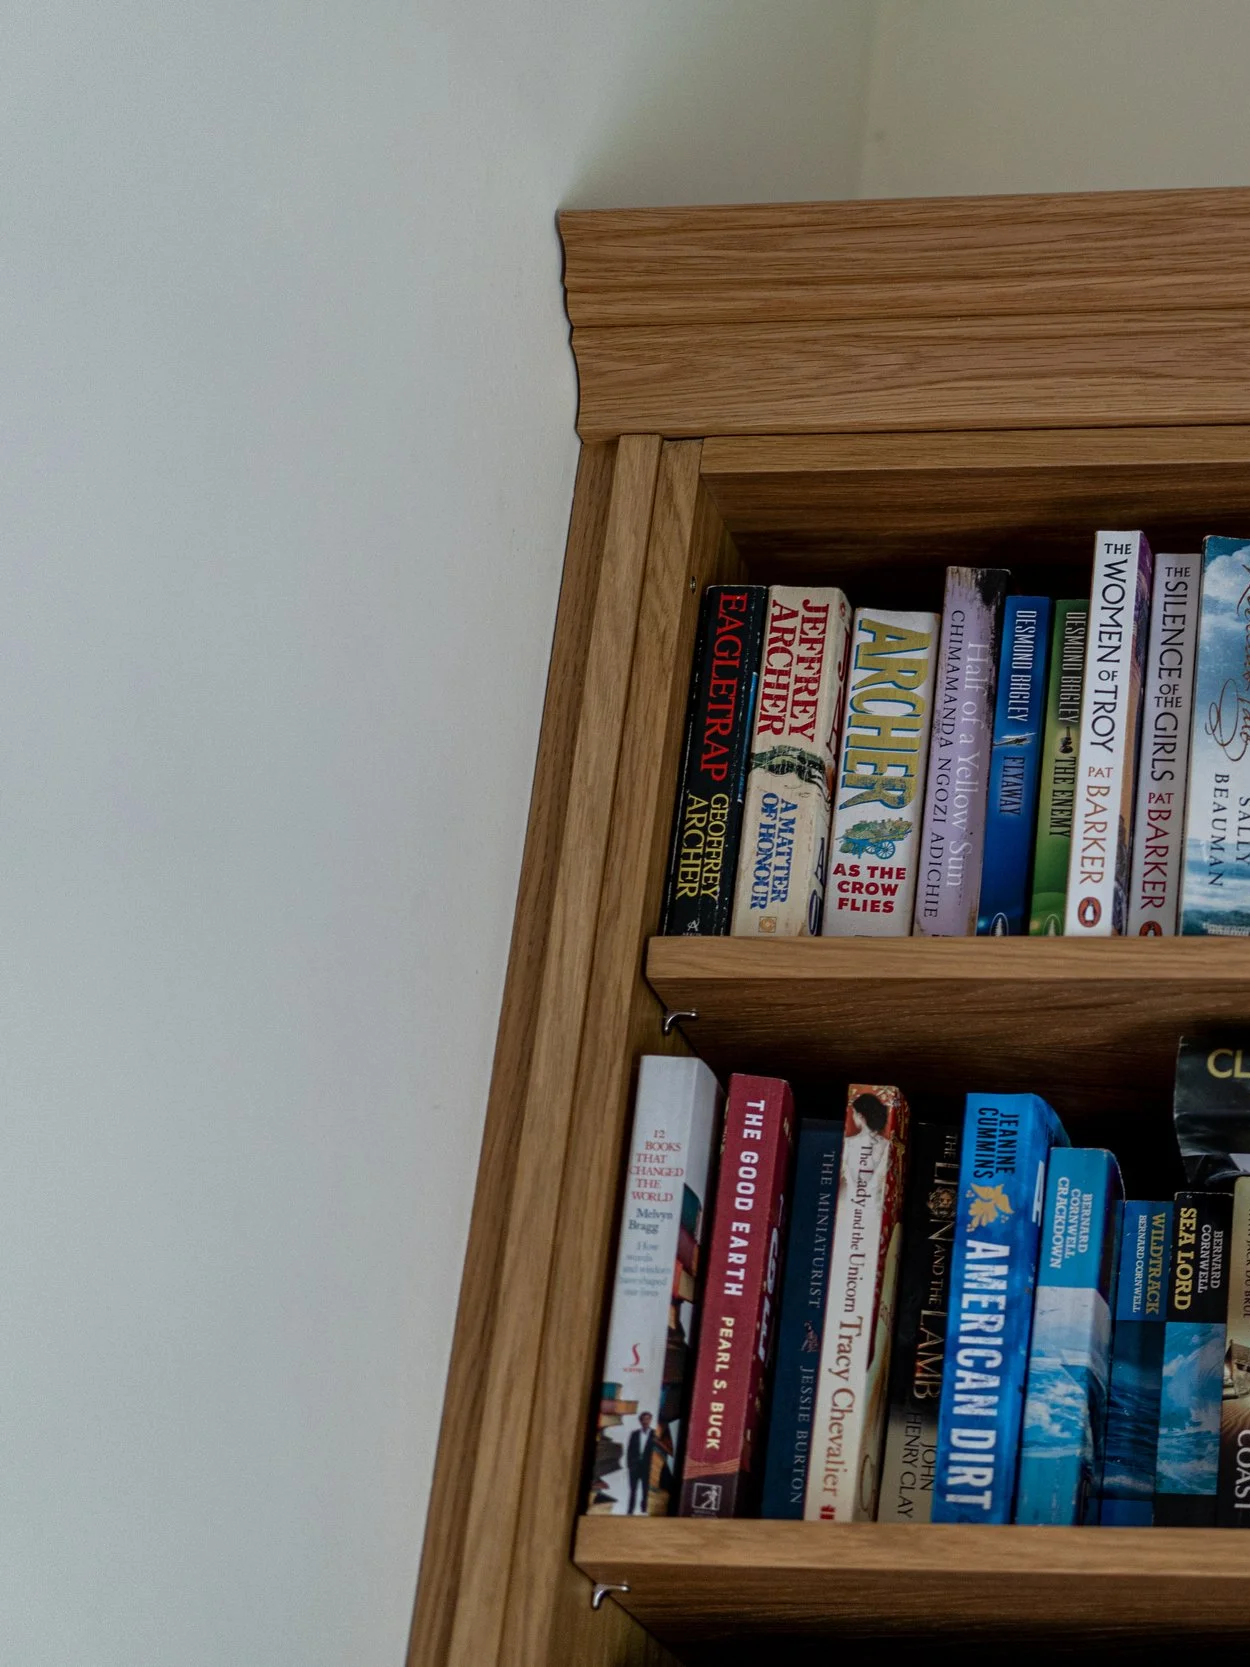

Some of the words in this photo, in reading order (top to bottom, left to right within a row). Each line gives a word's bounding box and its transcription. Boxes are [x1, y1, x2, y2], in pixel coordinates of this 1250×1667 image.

[1104, 543, 1132, 555] THE
[1165, 567, 1191, 577] THE
[1012, 610, 1037, 670] DESMOND
[1096, 558, 1128, 664] WOMEN
[1158, 581, 1188, 680] SILENCE
[757, 600, 799, 736] ARCHER
[788, 599, 830, 741] JEFFREY
[964, 643, 989, 696] Half
[1062, 612, 1087, 671] DESMOND
[700, 592, 748, 781] EAGLETRAP
[940, 610, 966, 748] CHIMAMANDA
[1007, 674, 1031, 722] BAGLEY
[1058, 676, 1082, 723] BAGLEY
[1098, 670, 1118, 682] OF
[1154, 696, 1182, 708] THE
[1159, 683, 1179, 695] OF
[839, 618, 932, 810] ARCHER
[1090, 685, 1118, 753] TROY
[1053, 756, 1076, 785] THE
[1087, 766, 1114, 778] PAT
[1150, 712, 1178, 782] GIRLS
[933, 758, 951, 822] NGOZI
[952, 752, 980, 830] Yellow
[1000, 756, 1025, 816] FLYAWAY
[1049, 789, 1073, 838] ENEMY
[1148, 792, 1175, 804] PAT
[676, 794, 709, 899] ARCHER
[700, 793, 729, 900] GEOFFREY
[1079, 785, 1110, 885] BARKER
[1140, 809, 1172, 910] BARKER
[1208, 773, 1229, 887] BEAUMAN
[750, 823, 776, 910] HONOUR
[770, 817, 796, 903] MATTER
[833, 863, 860, 877] AS
[867, 866, 906, 880] THE
[837, 880, 899, 897] CROW
[923, 832, 944, 918] ADICHIE
[837, 898, 895, 913] FLIES
[644, 1141, 682, 1151] BOOKS
[743, 1099, 765, 1140] THE
[973, 1107, 999, 1179] CUMMINS
[995, 1113, 1020, 1175] JEANINE
[629, 1166, 684, 1177] CHANGED
[636, 1153, 668, 1164] THAT
[636, 1178, 661, 1189] THE
[734, 1151, 759, 1211] GOOD
[820, 1151, 835, 1186] THE
[632, 1191, 673, 1202] WORLD
[851, 1169, 874, 1208] Lady
[852, 1208, 865, 1229] and
[1050, 1177, 1070, 1269] CRACKDOWN
[1065, 1188, 1082, 1259] CORNWELL
[1078, 1193, 1093, 1253] BERNARD
[1136, 1215, 1148, 1261] BERNARD
[1178, 1207, 1198, 1247] SEA
[724, 1222, 750, 1296] EARTH
[843, 1253, 866, 1312] Unicorn
[1132, 1260, 1145, 1313] CORNWELL
[1145, 1212, 1166, 1316] WILDTRACK
[1174, 1251, 1195, 1310] LORD
[1197, 1224, 1212, 1294] CORNWELL
[1210, 1230, 1224, 1289] BERNARD
[715, 1316, 735, 1373] PEARL
[828, 1316, 863, 1381] Tracy
[953, 1240, 1010, 1416] AMERICAN
[797, 1365, 815, 1422] JESSIE
[706, 1401, 725, 1450] BUCK
[822, 1388, 856, 1497] Chevalier
[902, 1412, 922, 1468] HENRY
[897, 1471, 917, 1519] CLAY
[945, 1428, 996, 1510] DIRT
